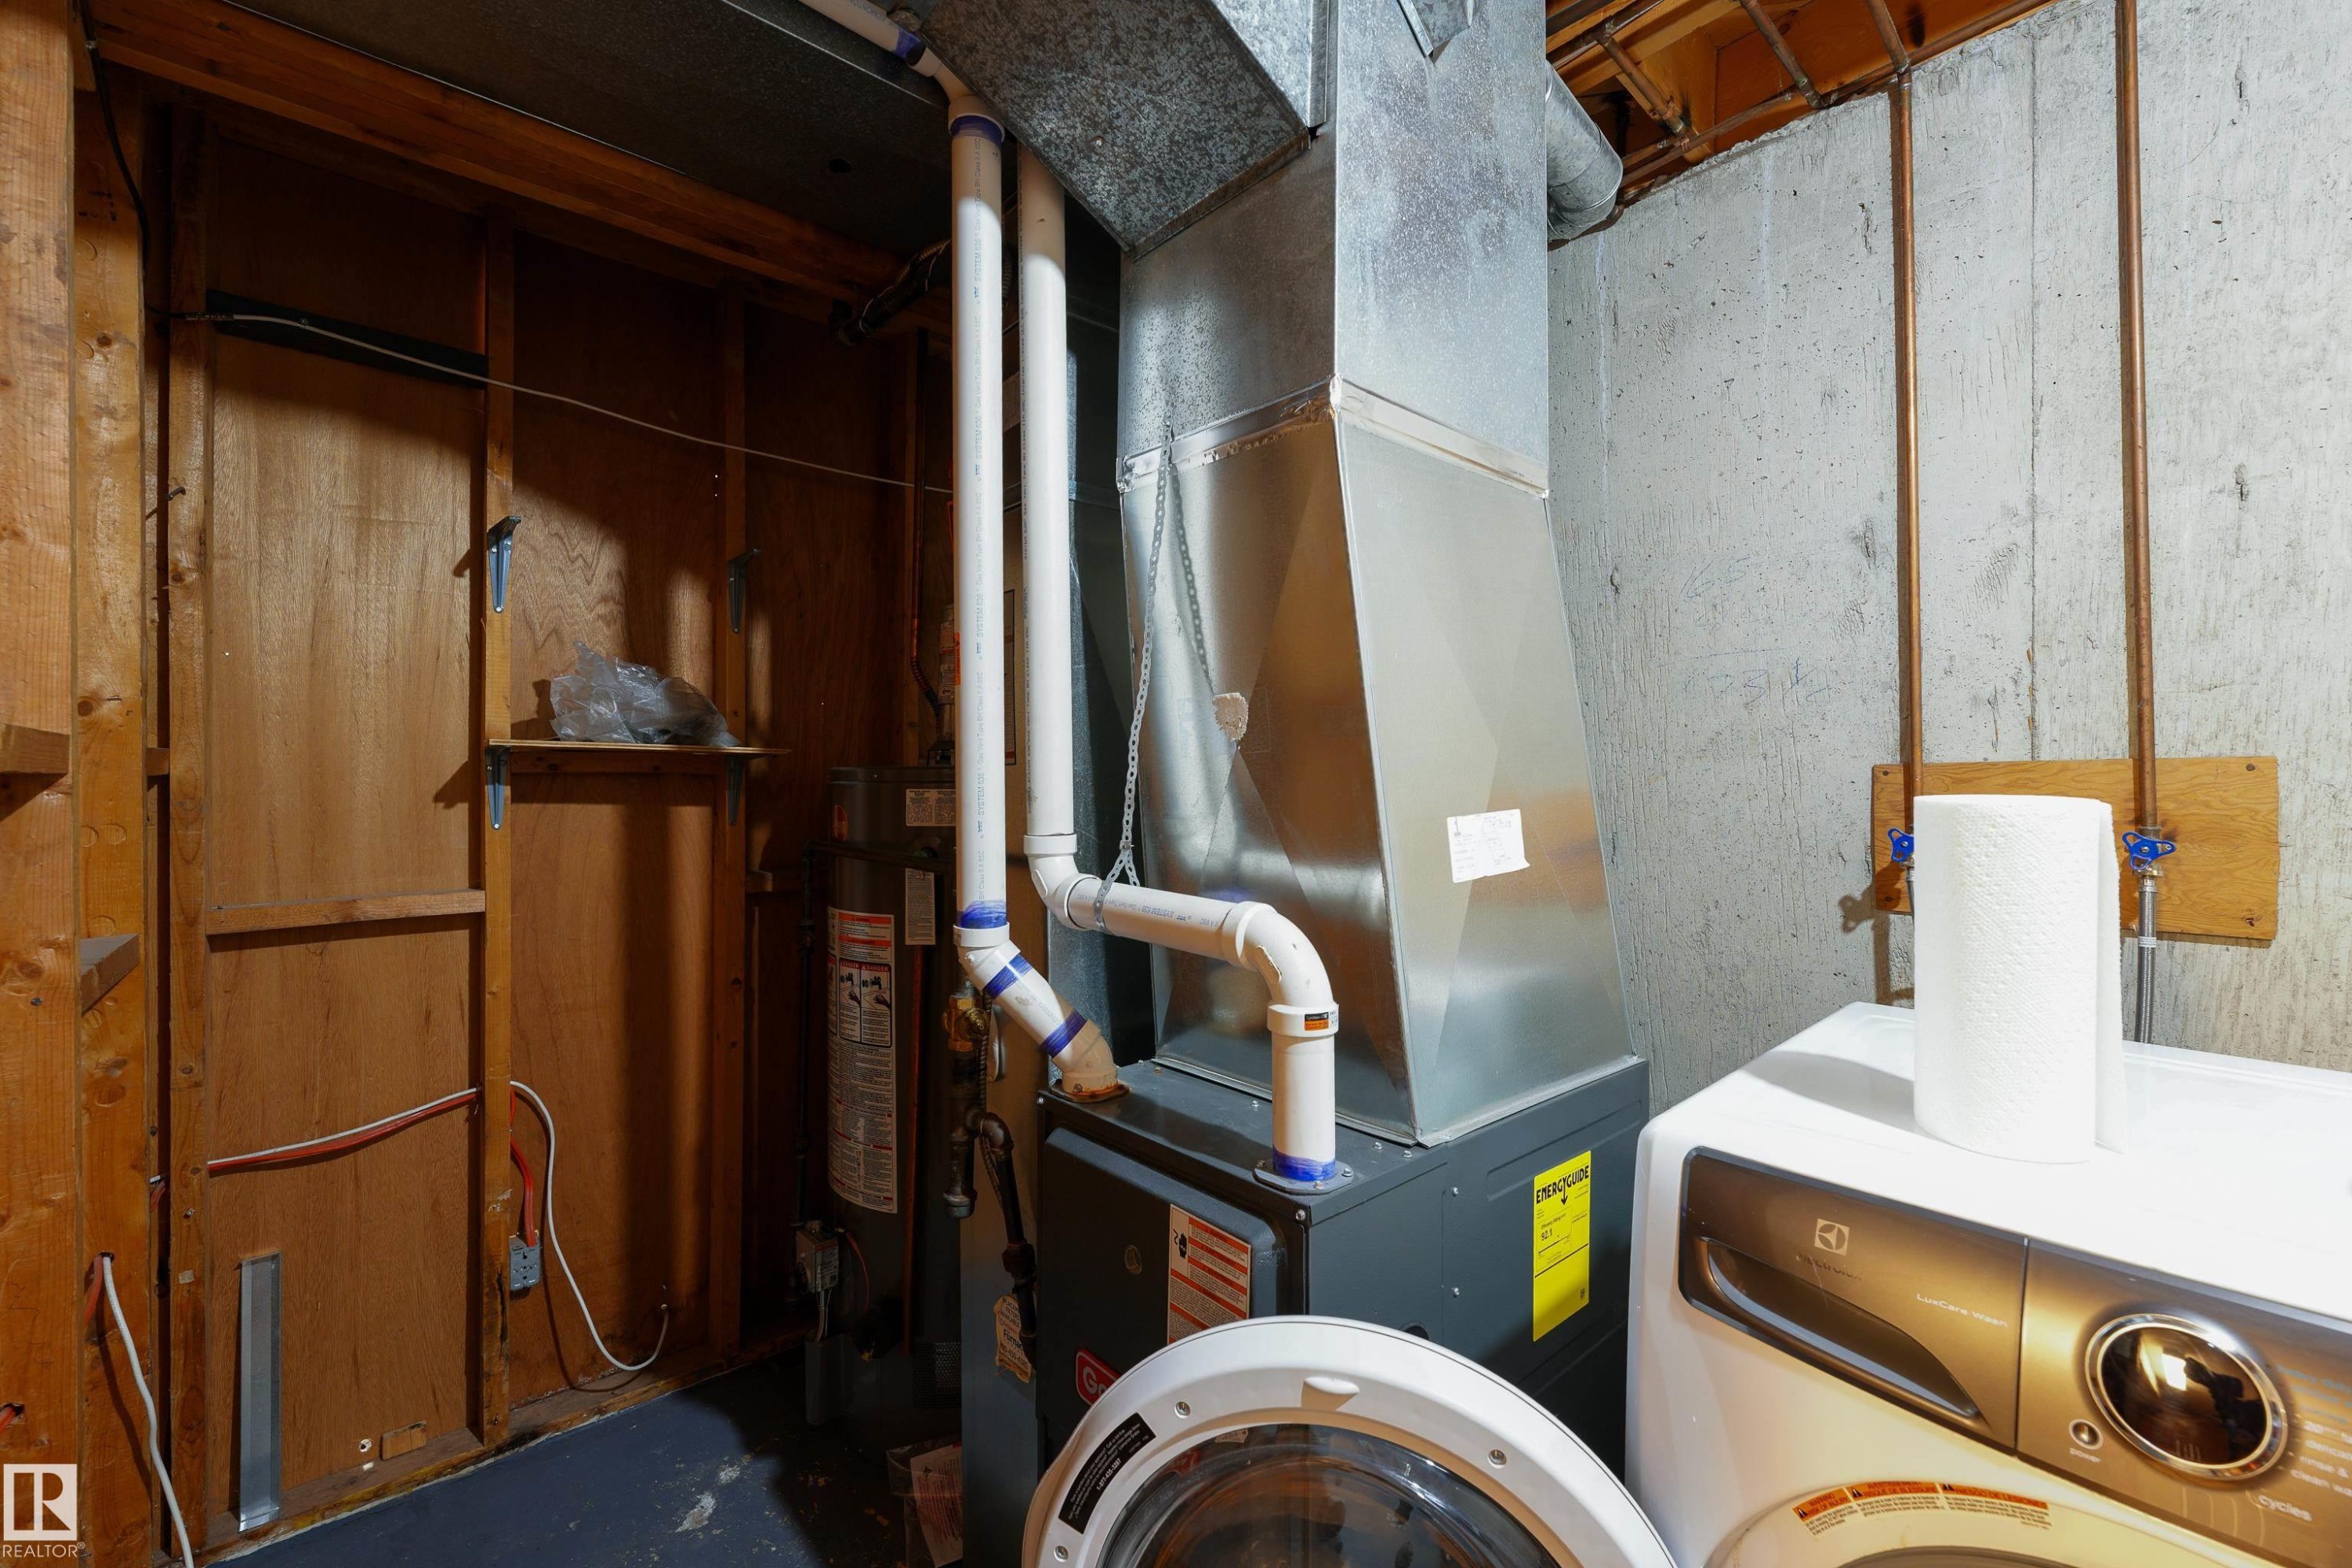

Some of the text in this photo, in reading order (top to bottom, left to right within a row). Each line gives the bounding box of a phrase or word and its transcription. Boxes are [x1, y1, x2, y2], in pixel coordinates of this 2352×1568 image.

[1152, 907, 1174, 918] SYSTEM
[1537, 1165, 1589, 1204] ENERGYGUIDE
[1541, 1229, 1552, 1241] 92.1
[1917, 1293, 2009, 1327] LuxCare Wash
[2070, 1447, 2101, 1464] power
[1096, 1458, 1122, 1490] 1-877-435-3287
[2291, 1469, 2330, 1489] clean
[2299, 1456, 2350, 1479] rinse &
[2258, 1494, 2313, 1522] cycles
